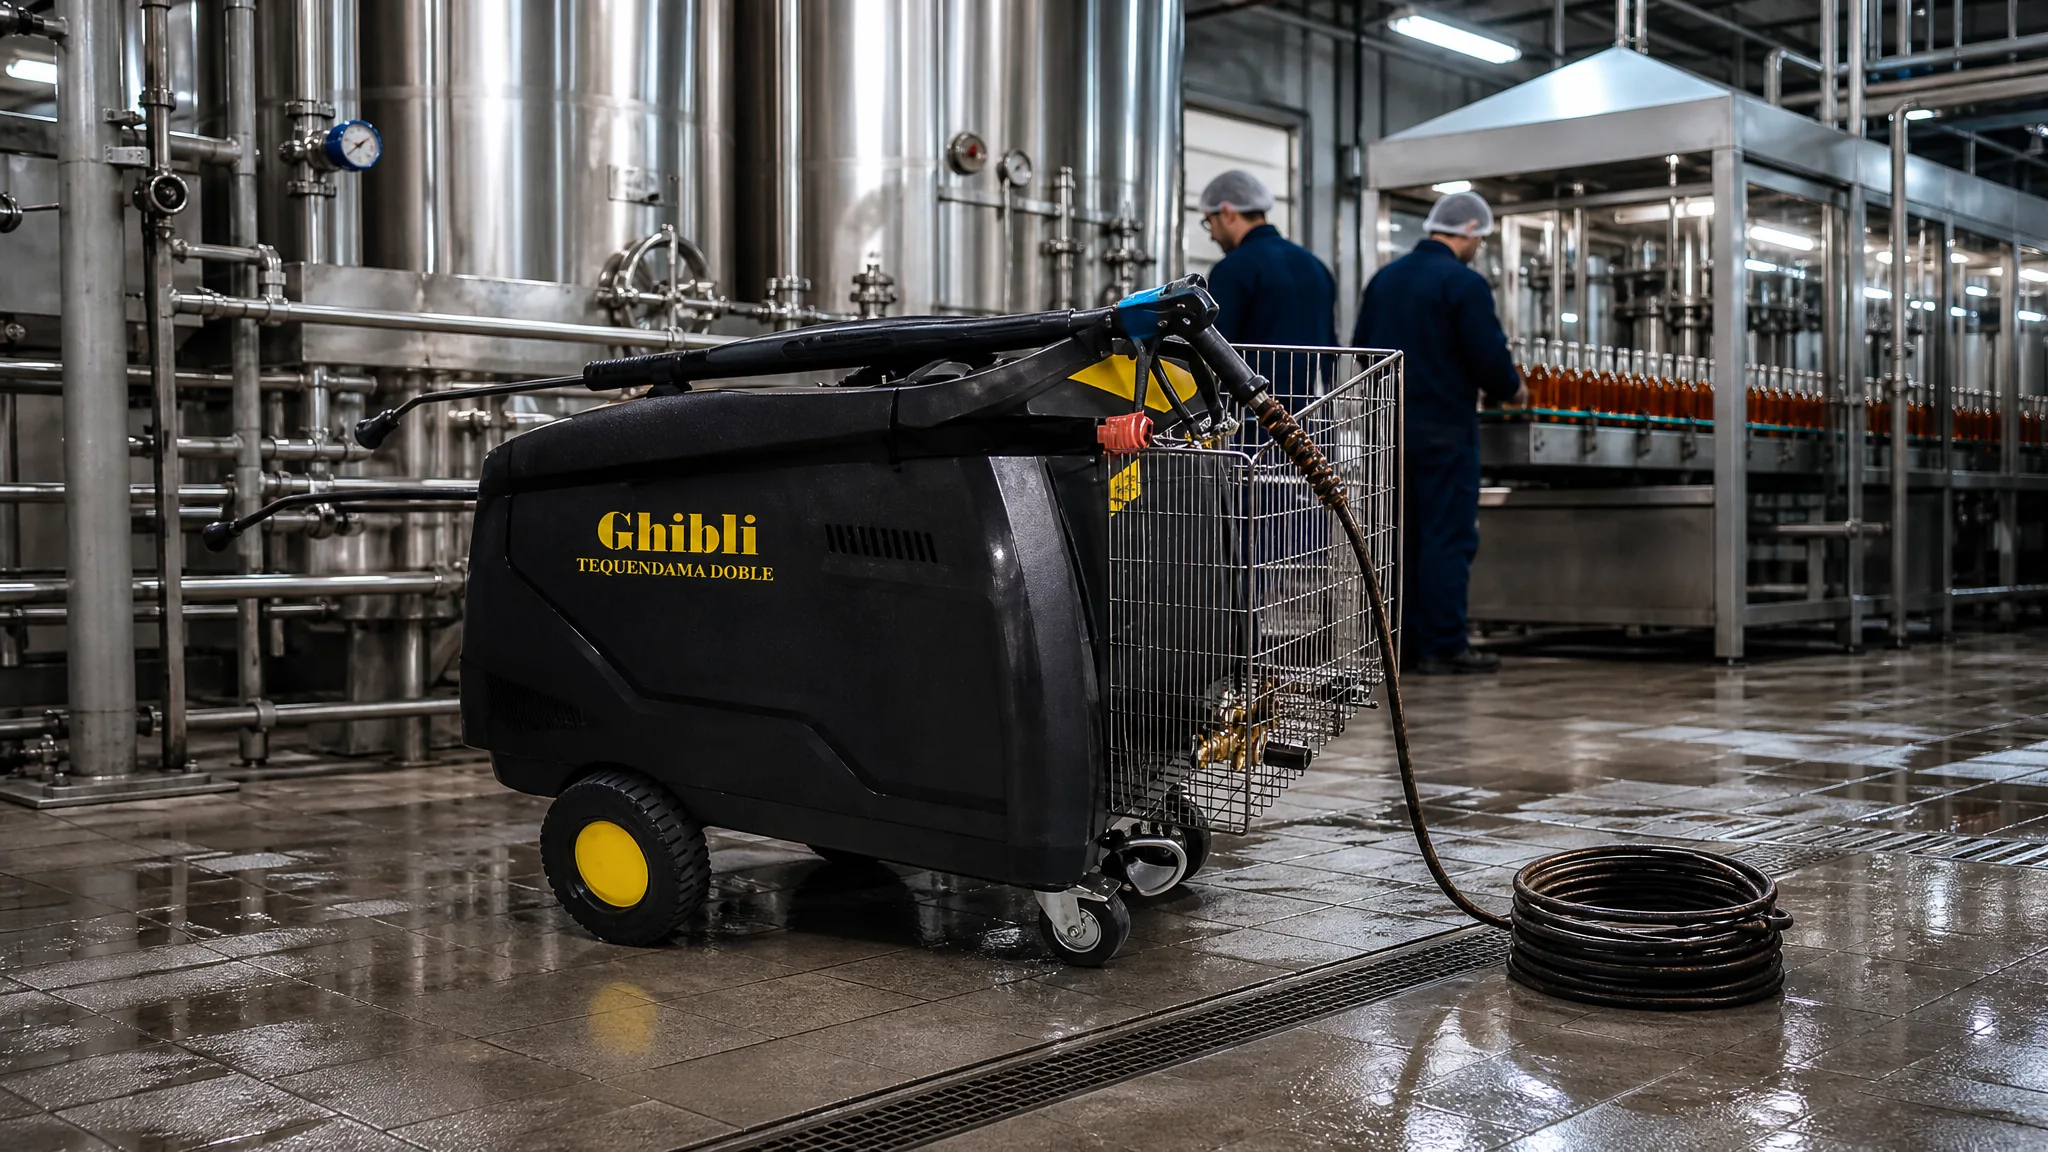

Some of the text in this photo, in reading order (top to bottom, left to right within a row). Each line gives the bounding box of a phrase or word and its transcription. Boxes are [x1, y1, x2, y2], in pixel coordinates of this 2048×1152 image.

[598, 511, 759, 555] Ghibli
[576, 557, 774, 581] TEQUENDAMA DOBLE
